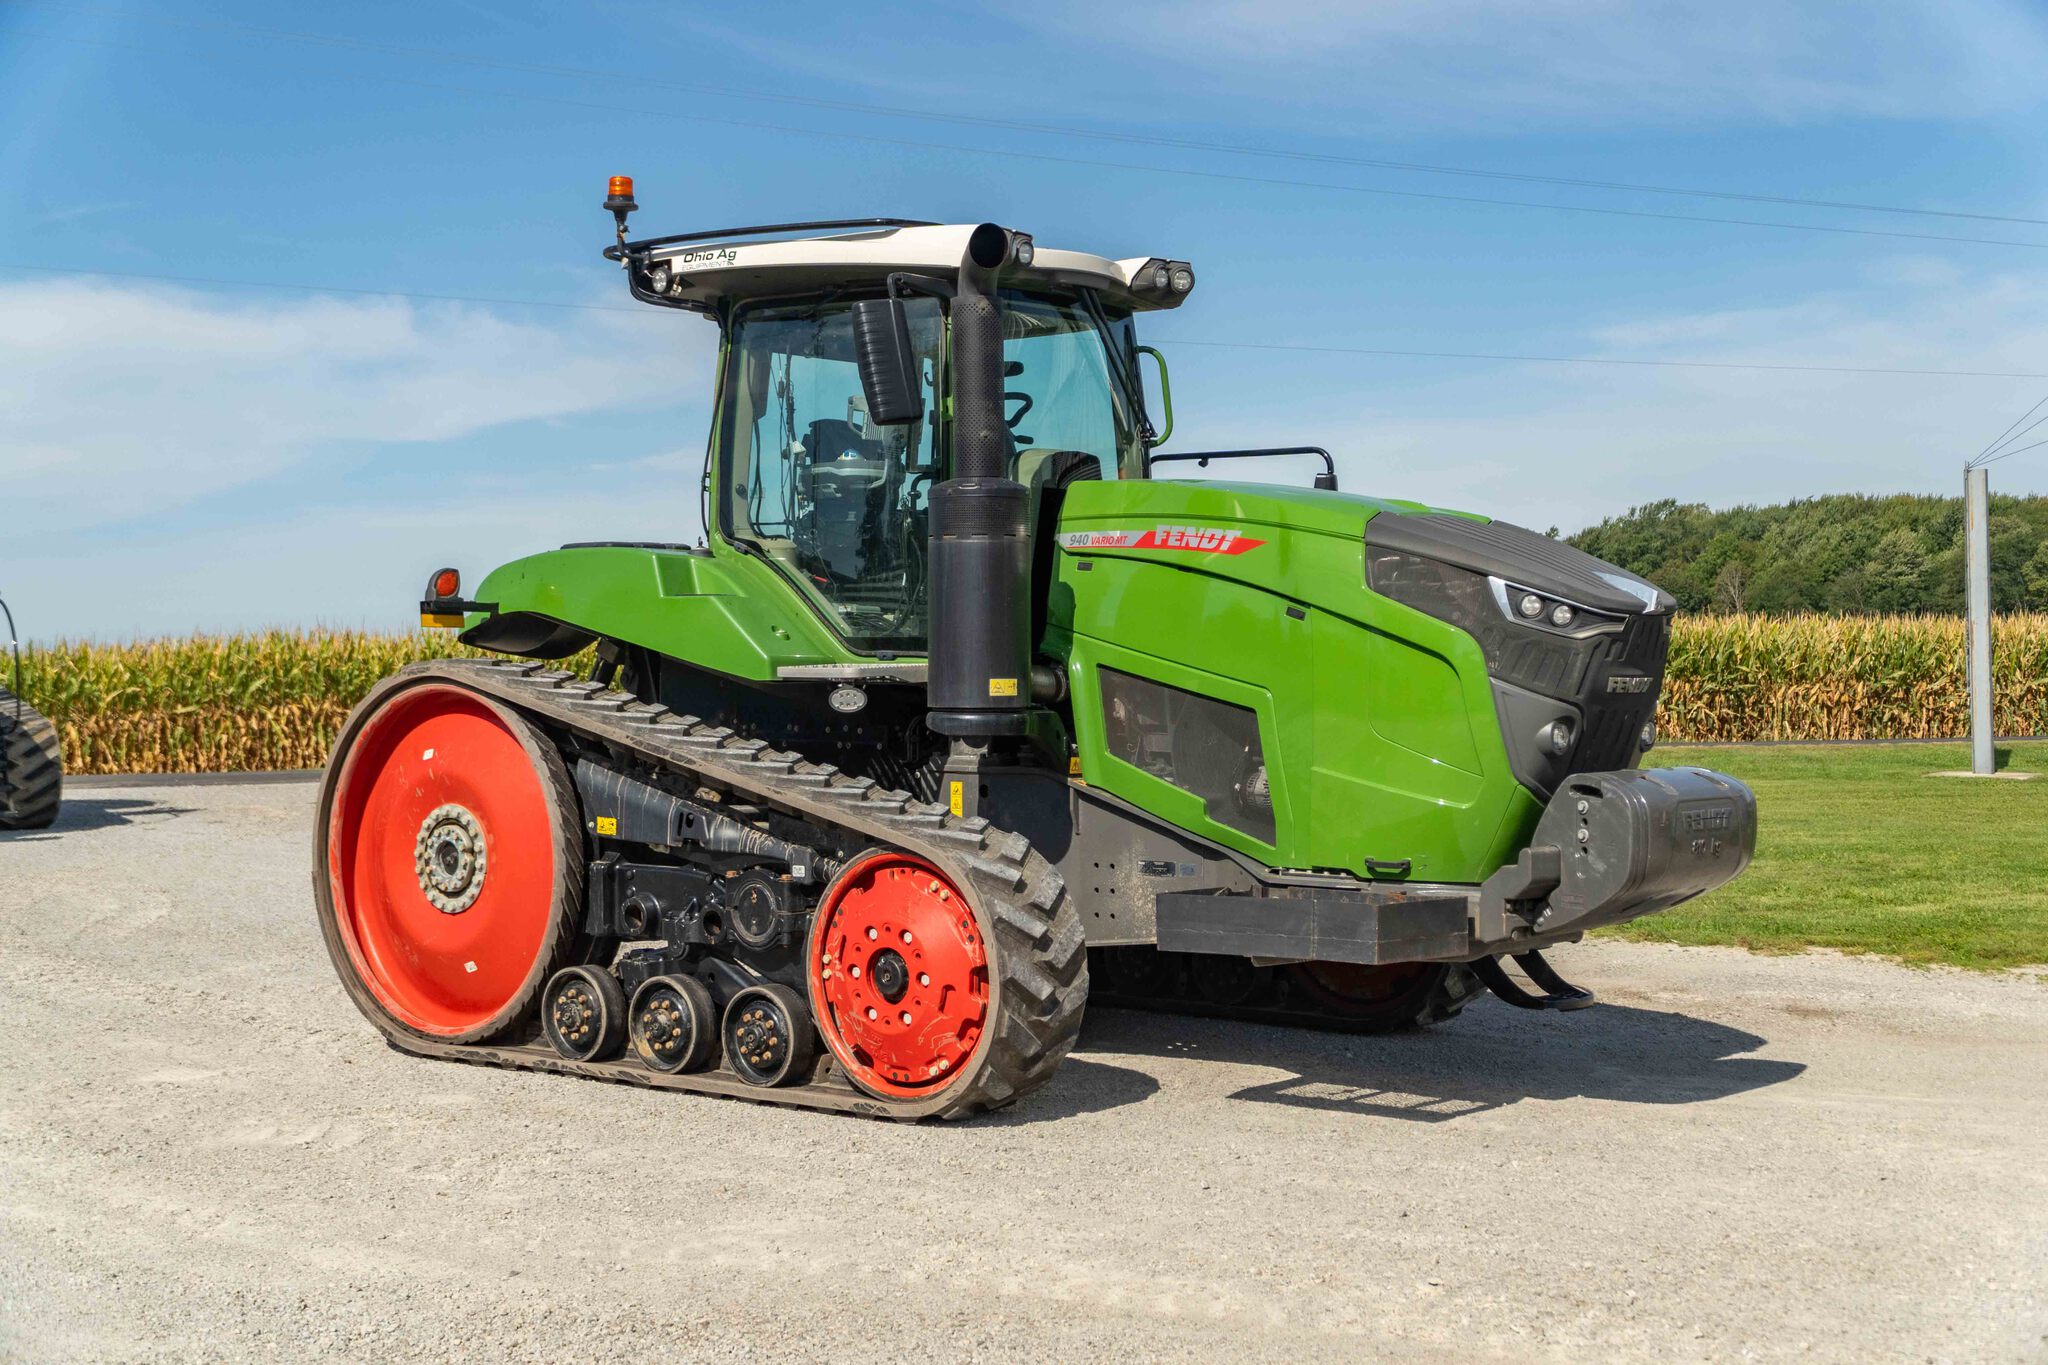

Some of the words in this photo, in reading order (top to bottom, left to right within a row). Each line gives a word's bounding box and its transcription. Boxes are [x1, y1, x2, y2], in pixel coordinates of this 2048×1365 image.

[683, 251, 714, 263] Ohio
[716, 248, 737, 261] Ag
[1069, 534, 1089, 546] 940
[1090, 535, 1115, 545] VARIO
[1115, 535, 1128, 545] MT
[1154, 524, 1242, 551] FENDT
[1606, 676, 1653, 693] FENDT
[1681, 807, 1732, 830] FENDT
